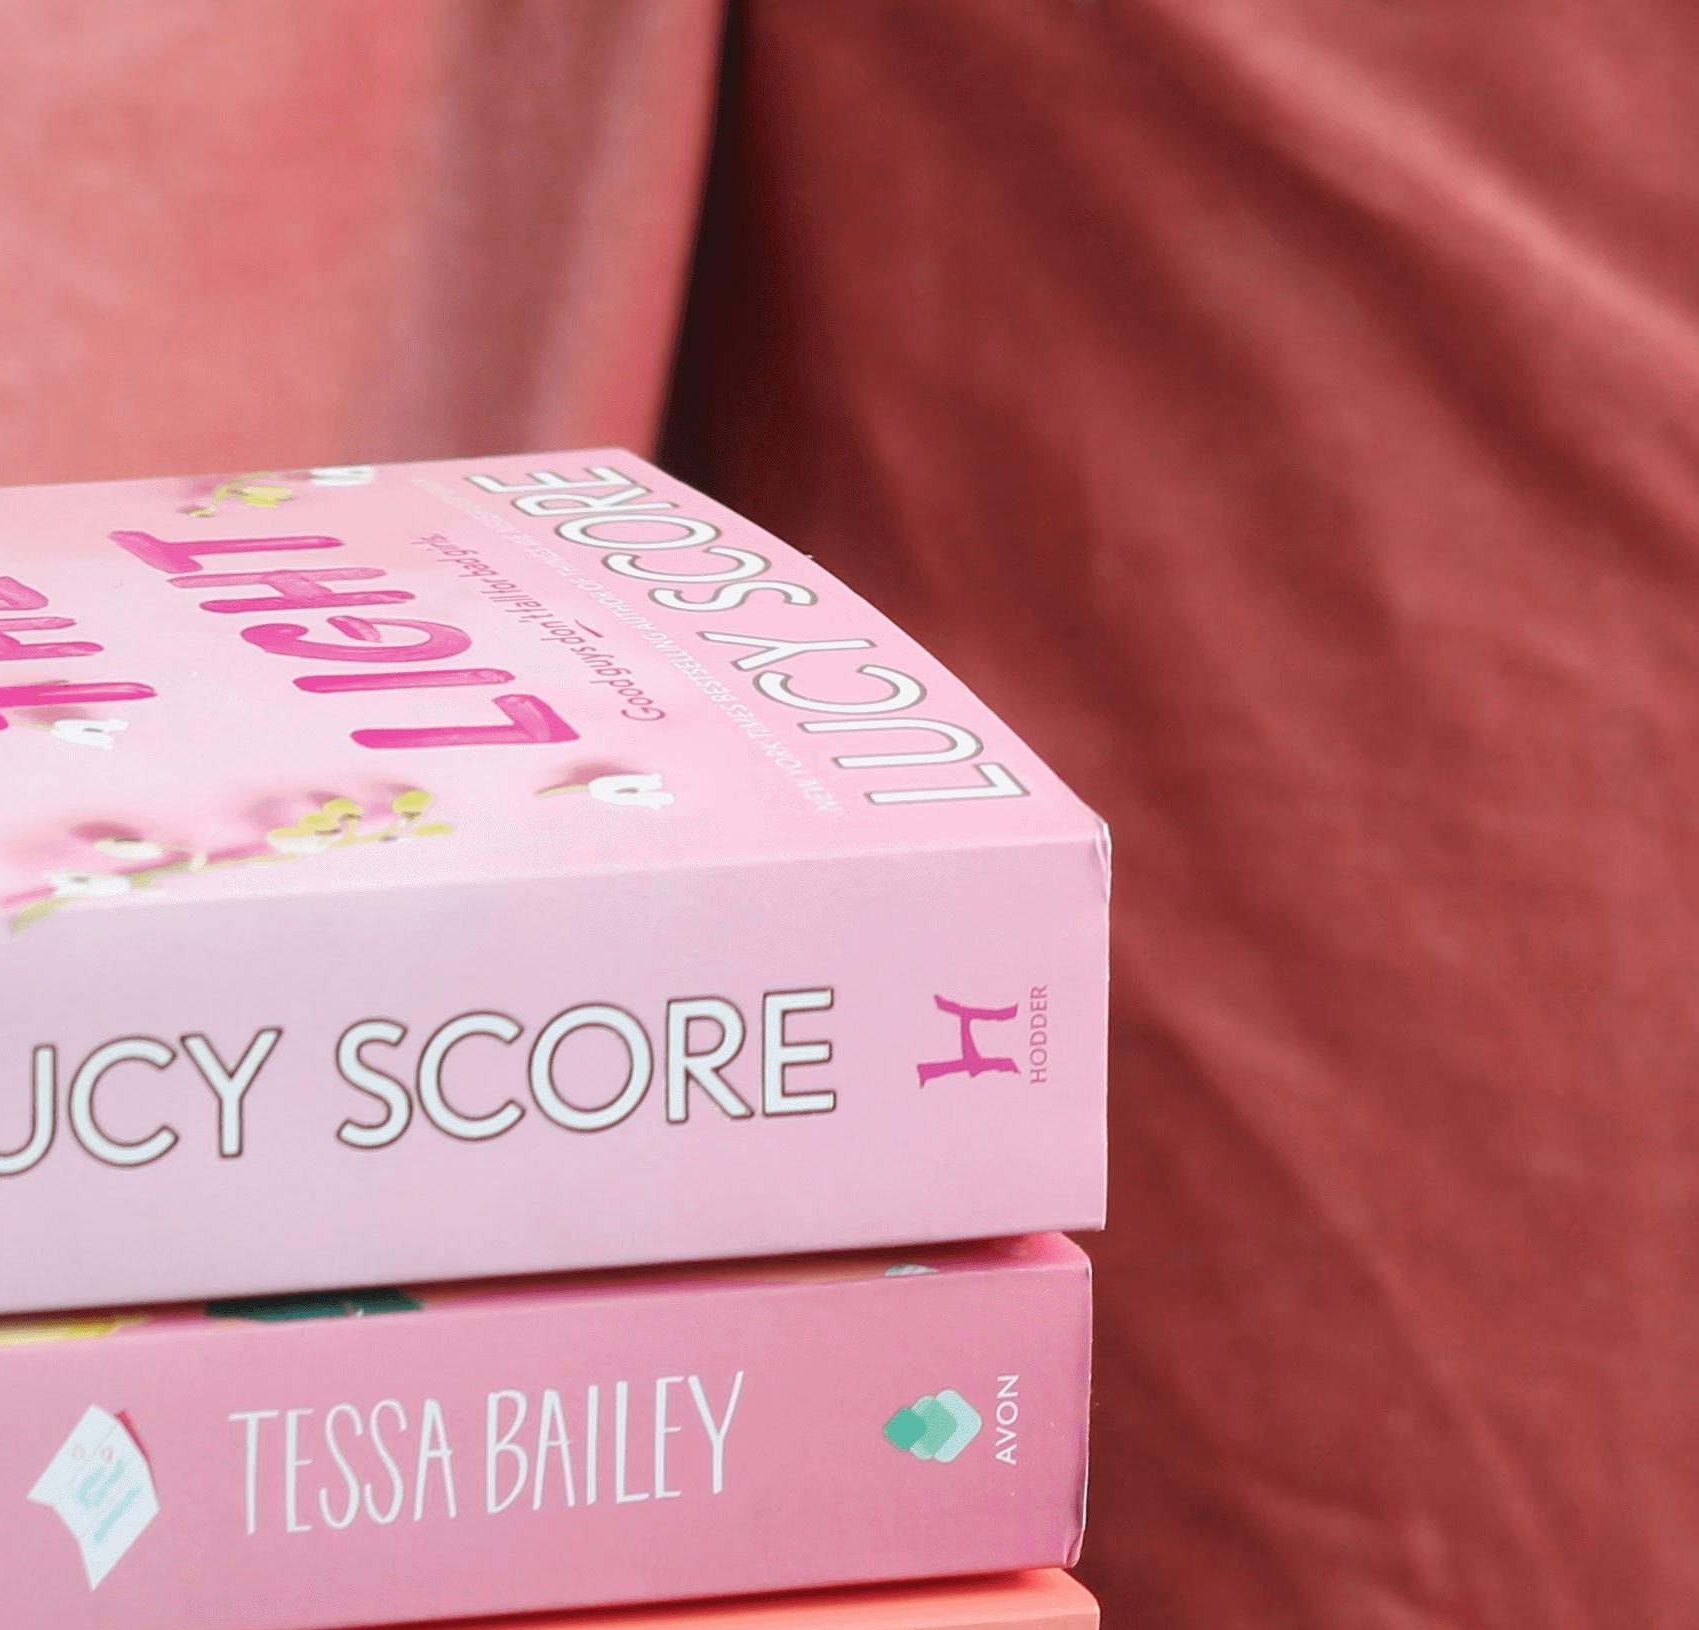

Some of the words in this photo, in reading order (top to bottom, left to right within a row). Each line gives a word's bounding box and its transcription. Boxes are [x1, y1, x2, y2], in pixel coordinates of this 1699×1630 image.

[464, 466, 819, 613] SCORE
[436, 557, 498, 578] bad
[480, 578, 523, 594] for
[488, 595, 548, 613] fall
[590, 591, 656, 630] AUTHOR
[109, 530, 580, 749] LIGHT
[518, 612, 586, 646] don't
[570, 646, 632, 677] guys
[641, 632, 737, 702] BESTSELLING
[589, 678, 667, 722] Good
[695, 630, 1030, 805] LUCY
[720, 703, 773, 738] TIMES
[759, 740, 808, 777] YORK
[1029, 984, 1048, 1084] HODDER
[333, 984, 838, 1150] SCORE
[993, 1372, 1021, 1467] AVON
[228, 1397, 458, 1535] TESSA
[485, 1369, 745, 1516] BAILEY
